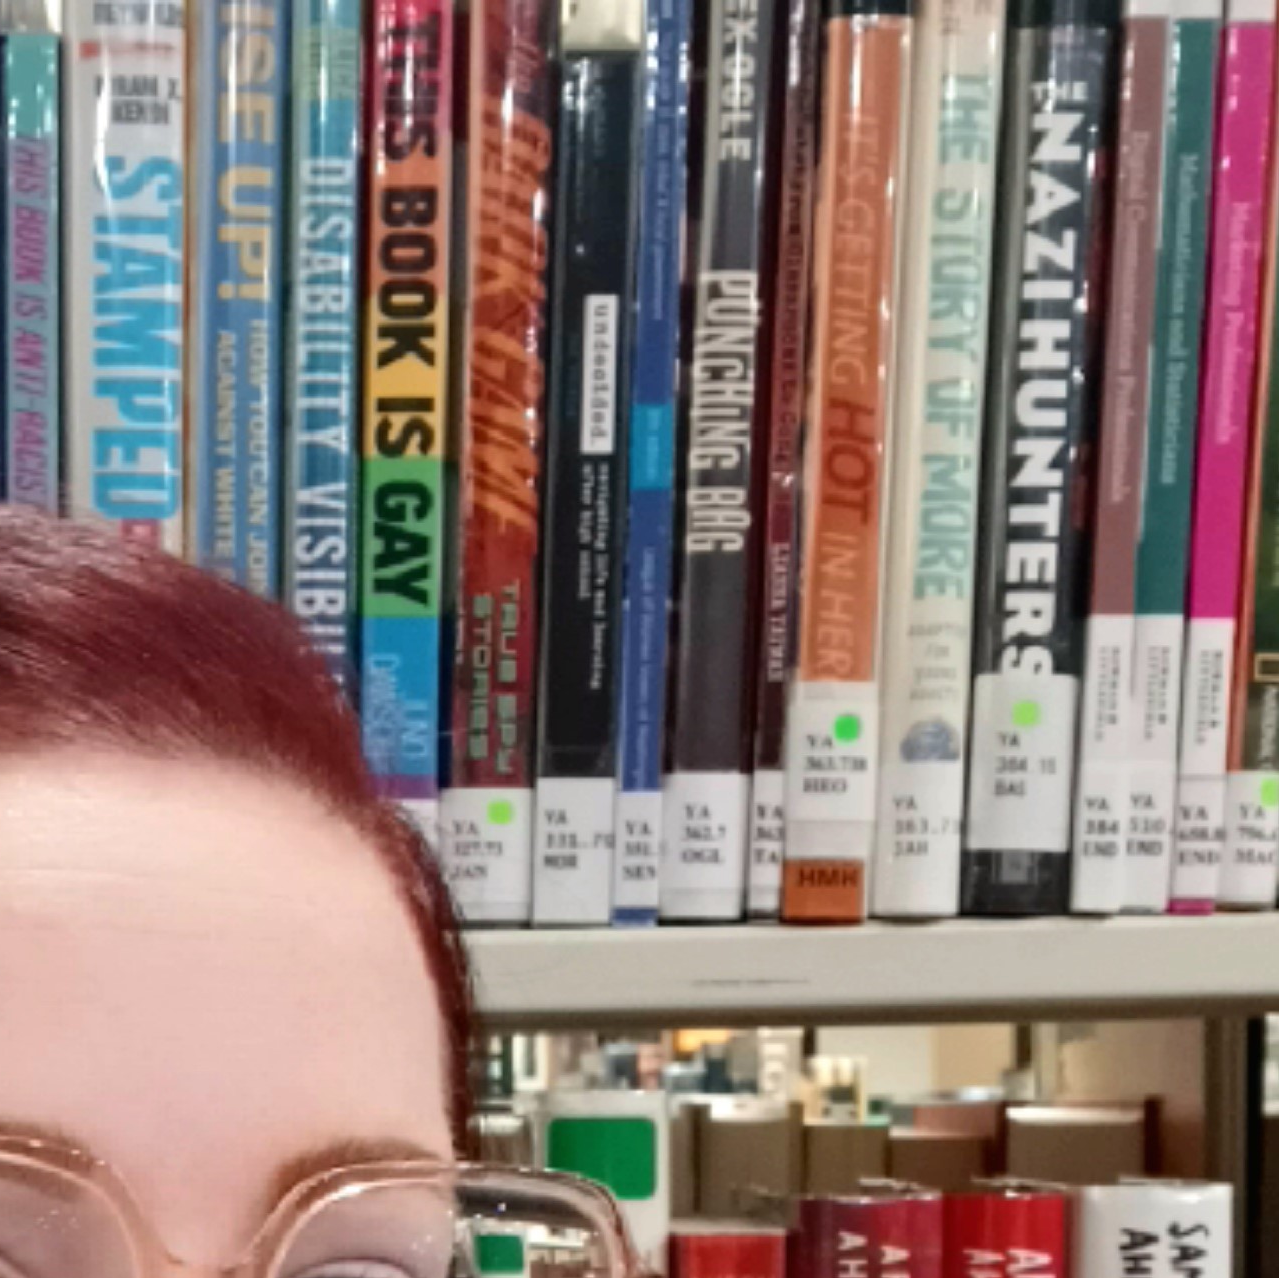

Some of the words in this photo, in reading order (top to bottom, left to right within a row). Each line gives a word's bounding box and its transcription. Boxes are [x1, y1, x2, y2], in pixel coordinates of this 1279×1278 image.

[219, 0, 275, 144] ISE
[383, 10, 442, 162] THIS
[719, 48, 756, 161] OGLE
[938, 70, 993, 164] THE
[12, 205, 49, 282] BOOK
[218, 162, 275, 301] UP!
[1023, 111, 1086, 300] NAZI
[1170, 154, 1201, 313] Mathematicians
[12, 293, 48, 322] IS
[296, 154, 356, 454] DISABILITY
[377, 185, 438, 368] BOOK
[830, 199, 873, 386] GETTING
[927, 187, 982, 362] STORY
[92, 154, 183, 519] STAMPED
[248, 320, 271, 389] HOW
[688, 269, 761, 469] PUNCHING
[10, 330, 49, 498] ANTI-RACIS
[215, 328, 238, 460] AGAINST
[248, 398, 270, 456] YOU
[375, 396, 435, 460] IS
[925, 377, 979, 440] OF
[1159, 360, 1188, 485] Statisticians
[248, 456, 270, 524] CAN
[824, 398, 876, 525] HOT
[213, 467, 236, 558] WHITE
[374, 479, 435, 608] GAY
[685, 486, 752, 554] BAG
[824, 529, 858, 575] IN
[913, 452, 971, 601] MORE
[817, 585, 855, 680] HER
[807, 735, 834, 749] YA
[998, 733, 1021, 747] YA
[544, 810, 568, 826] YA
[625, 819, 651, 835] YA
[685, 805, 711, 820] YA
[891, 796, 917, 811] YA
[1085, 797, 1109, 812] YA
[1131, 794, 1154, 809] YA
[798, 868, 858, 888] HMH
